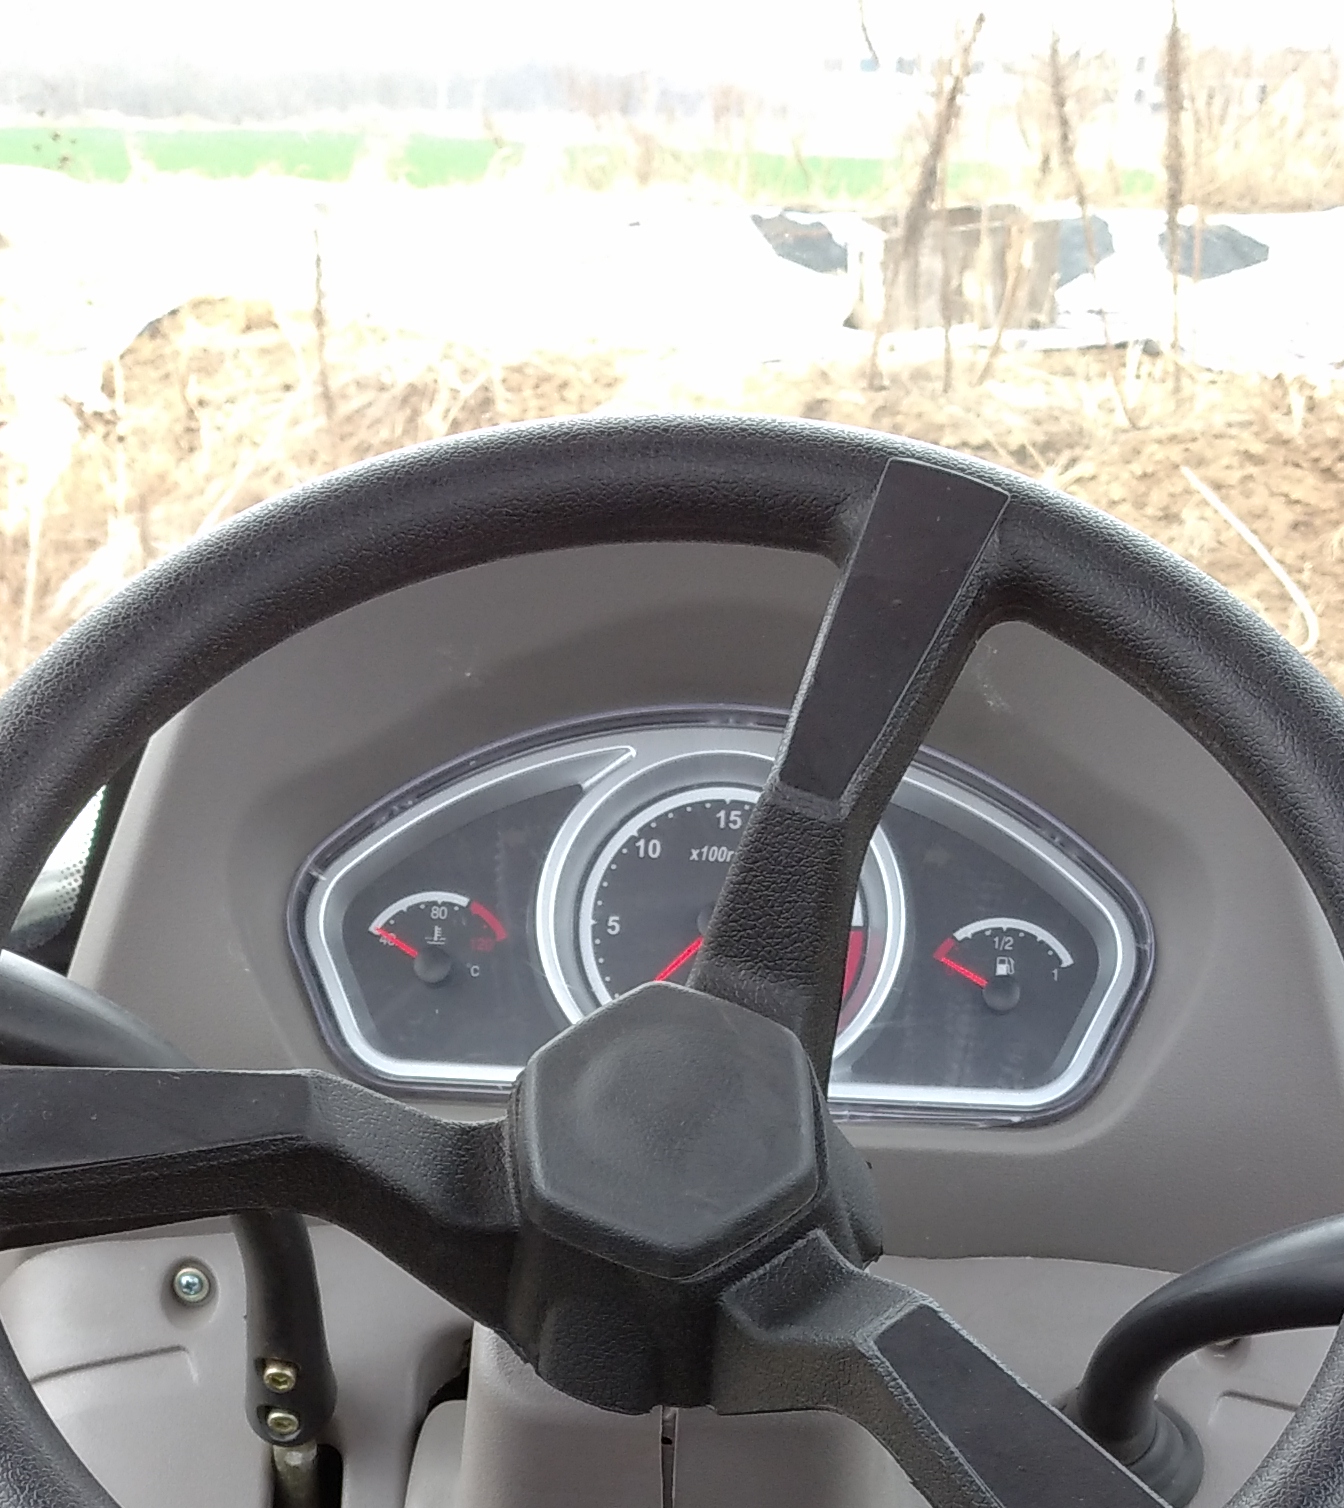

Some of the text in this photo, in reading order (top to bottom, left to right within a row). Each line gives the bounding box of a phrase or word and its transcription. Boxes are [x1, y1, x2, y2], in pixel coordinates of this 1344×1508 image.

[716, 810, 742, 830] 15
[635, 839, 661, 859] 10
[689, 845, 737, 862] x100r
[430, 906, 448, 920] 80
[606, 916, 620, 935] 5
[993, 936, 1014, 950] 1/2
[1052, 968, 1058, 981] 1
